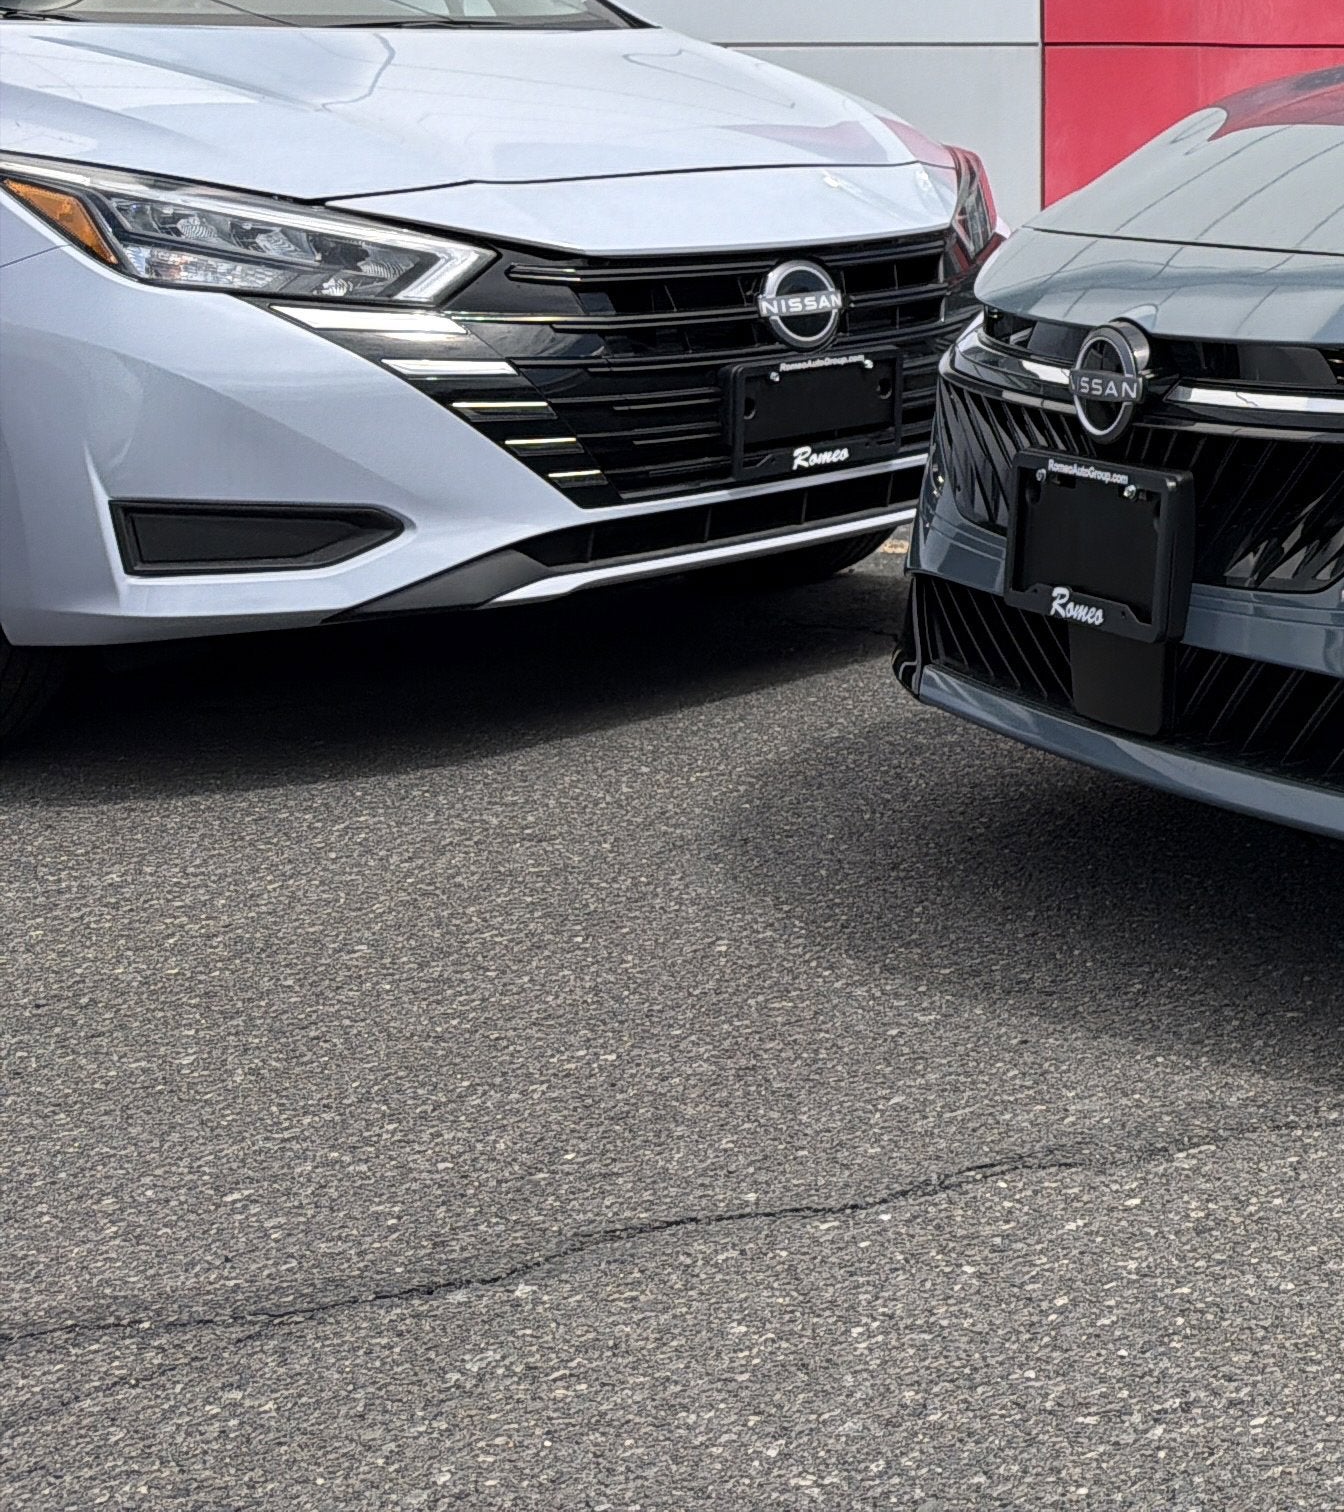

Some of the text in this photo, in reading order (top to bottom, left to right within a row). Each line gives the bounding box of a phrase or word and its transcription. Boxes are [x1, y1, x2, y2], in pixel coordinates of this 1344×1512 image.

[760, 292, 843, 316] NISSAN
[792, 445, 850, 470] Romeo
[1050, 586, 1105, 626] Romeo
